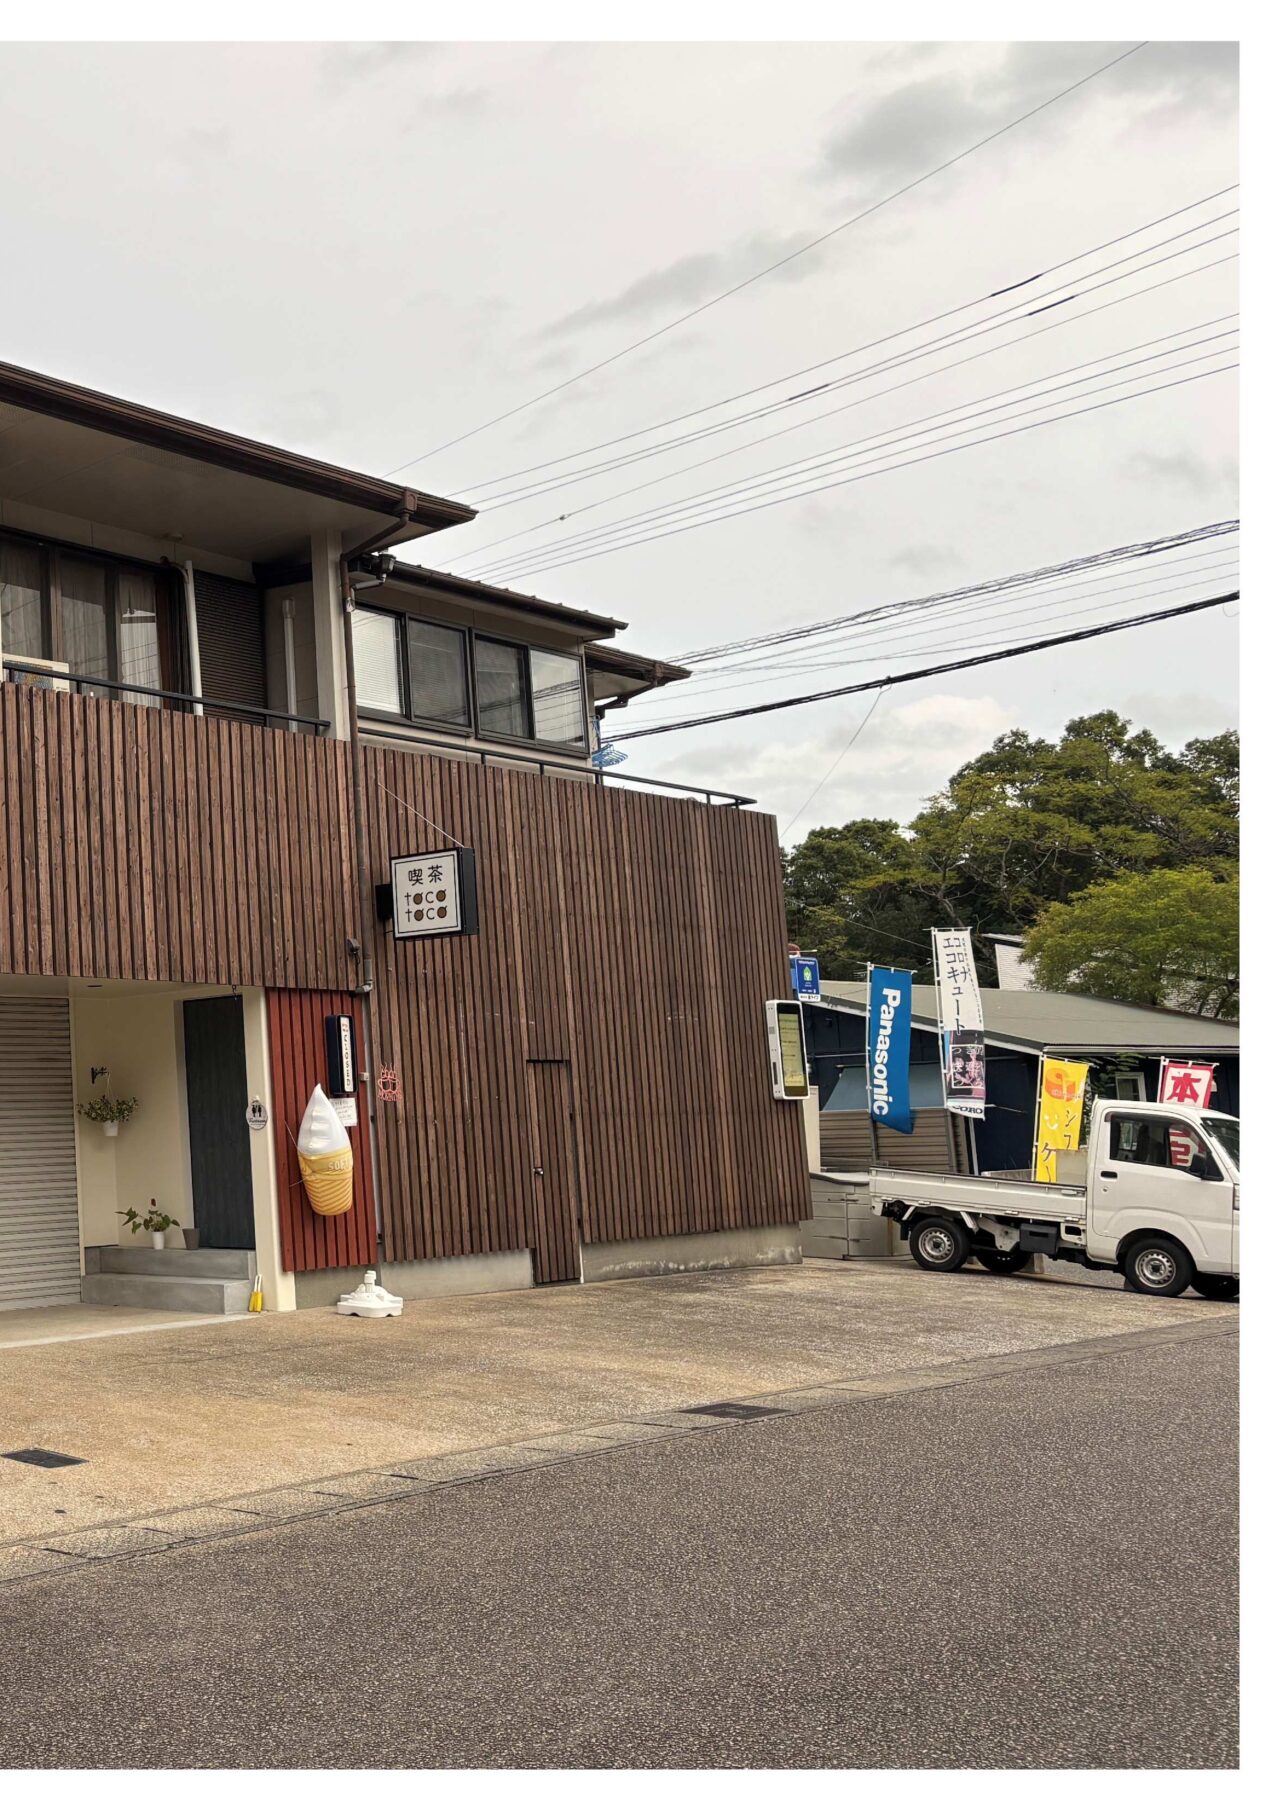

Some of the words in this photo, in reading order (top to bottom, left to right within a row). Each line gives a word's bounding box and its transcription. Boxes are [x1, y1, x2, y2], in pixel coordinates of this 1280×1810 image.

[407, 864, 443, 887] 喫茶
[942, 937, 966, 1035] エコキュート
[953, 937, 969, 983] コロナ
[872, 987, 902, 1117] Panasonic
